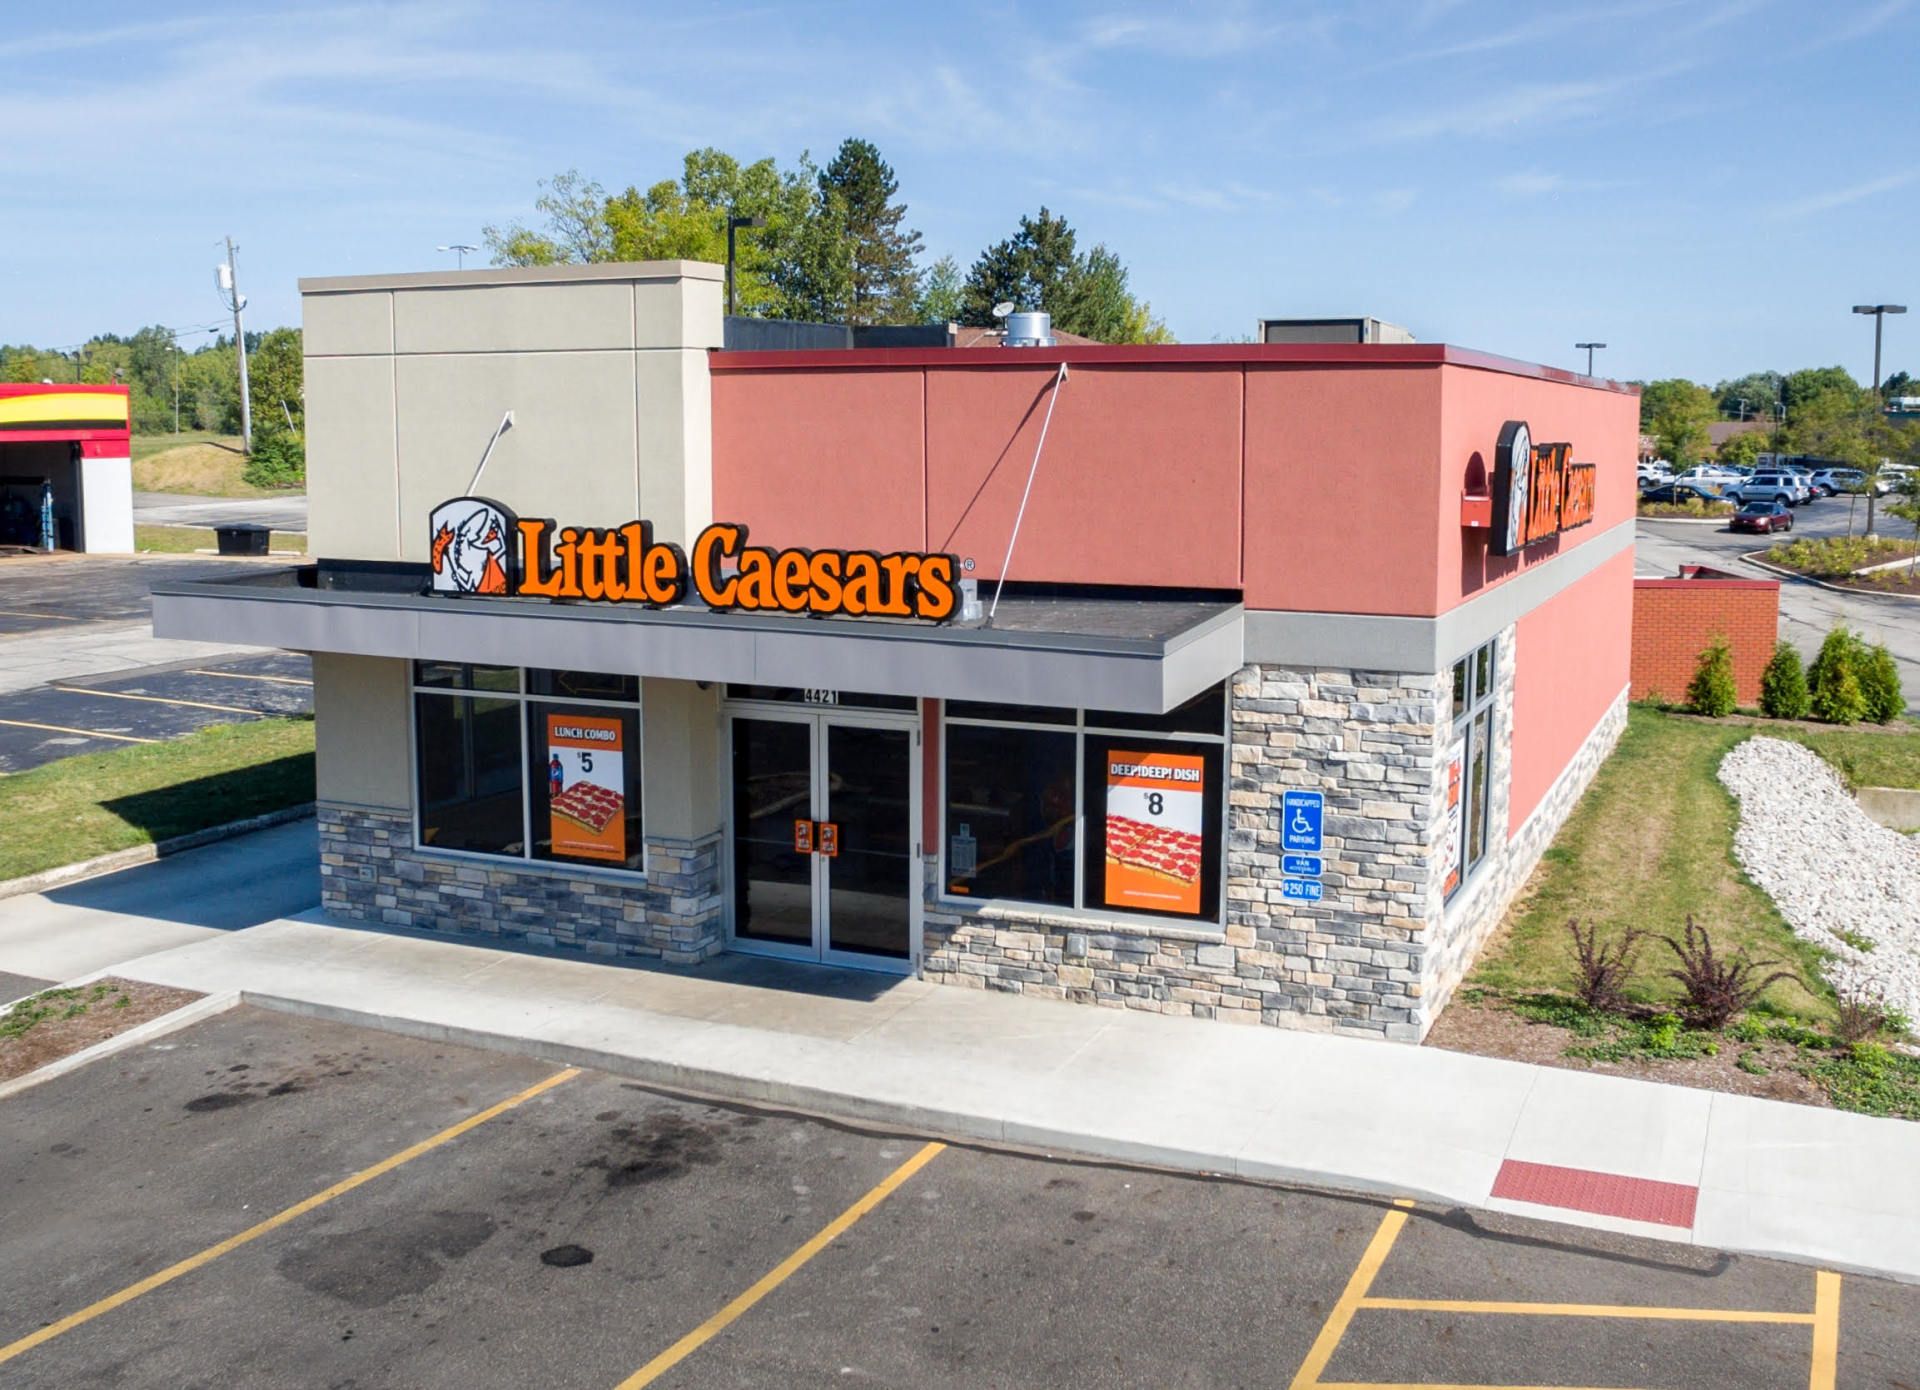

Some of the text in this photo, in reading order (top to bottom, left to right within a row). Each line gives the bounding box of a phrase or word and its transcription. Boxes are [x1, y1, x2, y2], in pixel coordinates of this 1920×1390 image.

[517, 520, 679, 602] Little
[693, 526, 953, 618] Caesars
[805, 689, 837, 704] 4421
[554, 726, 616, 741] LUNCH COMBO
[1173, 768, 1200, 782] DISH
[1286, 798, 1321, 808] HANDICAPPED
[1289, 834, 1316, 845] PARKING
[1295, 859, 1310, 867] VAN
[1284, 882, 1321, 897] $250 FINE
